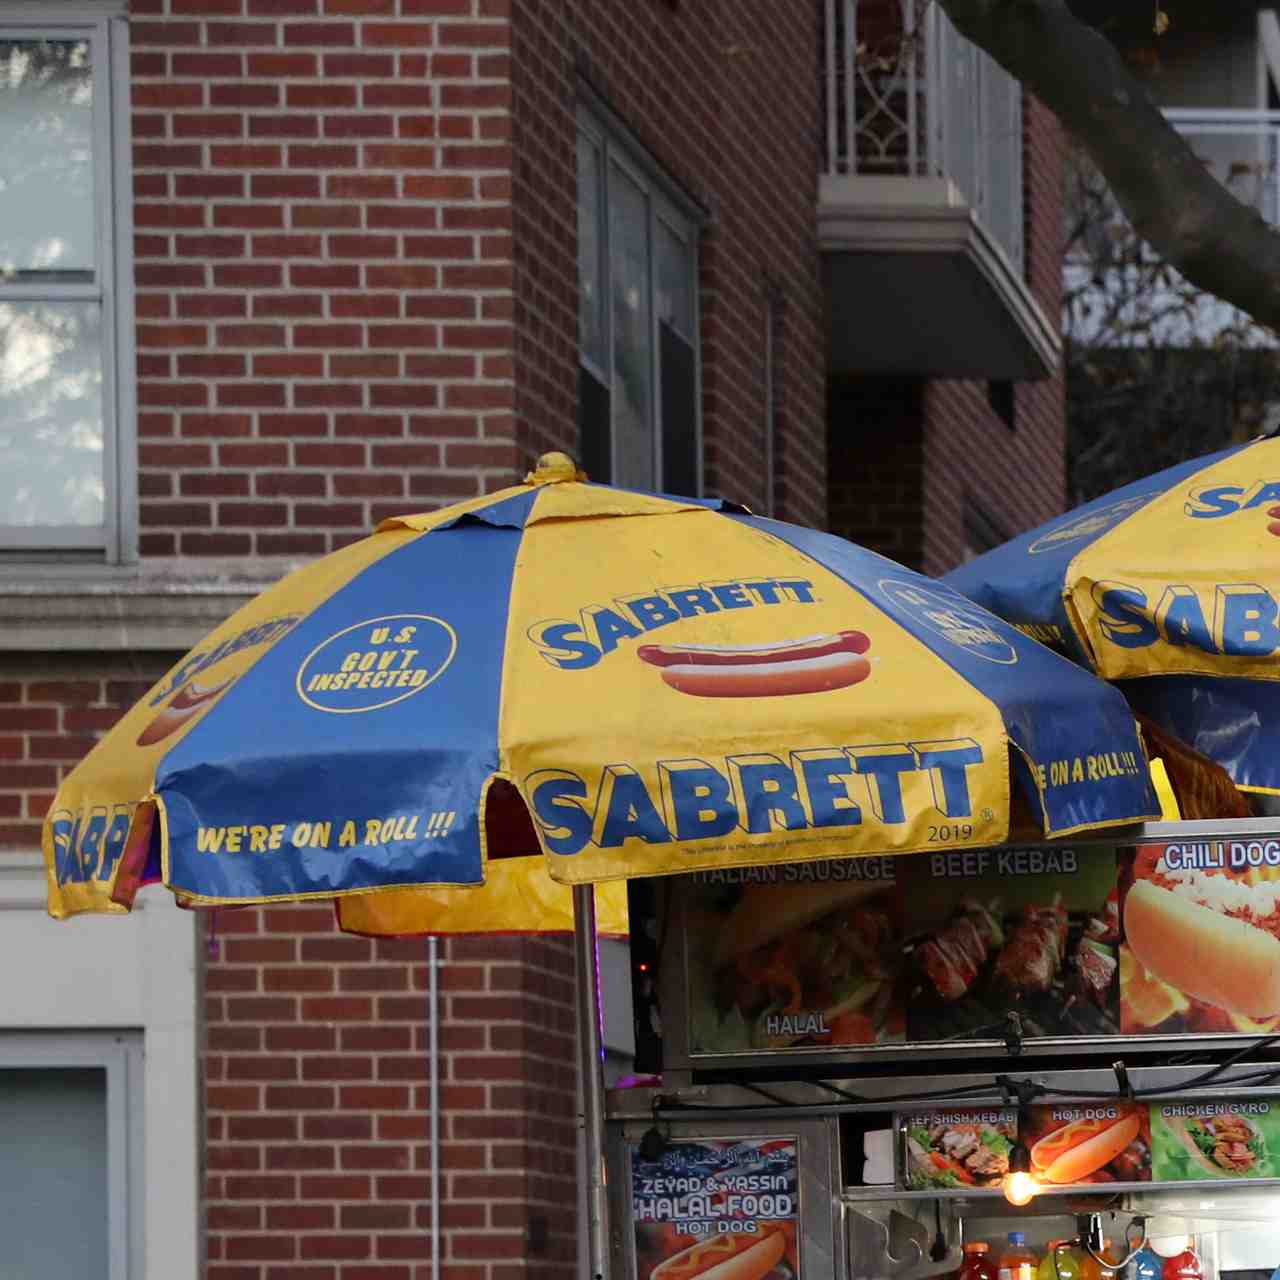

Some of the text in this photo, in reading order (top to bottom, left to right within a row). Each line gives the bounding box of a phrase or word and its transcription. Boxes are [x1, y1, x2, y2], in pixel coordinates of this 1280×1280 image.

[526, 577, 815, 670] SABRETT
[371, 626, 414, 646] U.S.
[340, 648, 415, 674] GOV'T
[306, 667, 428, 693] INSPECTED
[1050, 759, 1069, 787] ON
[1072, 757, 1084, 782] A
[523, 737, 983, 856] SABRETT
[197, 824, 283, 854] WE'RE
[291, 823, 332, 848] ON
[339, 824, 356, 846] A
[365, 819, 417, 844] ROLL
[927, 825, 973, 842] 2019
[931, 848, 1077, 878] BEEF KEBAB
[1164, 840, 1280, 869] CHILI DOG
[784, 857, 897, 881] SAUSAGE
[766, 1014, 830, 1035] HALAL
[934, 1112, 969, 1124] SHISH
[1053, 1108, 1117, 1121] HOT DOG
[1162, 1102, 1269, 1117] CHICKEN GYRO
[642, 1175, 788, 1193] ZEYAD & YASSIN
[639, 1194, 792, 1219] HALAL FOOD
[676, 1220, 757, 1234] HOT DOG
